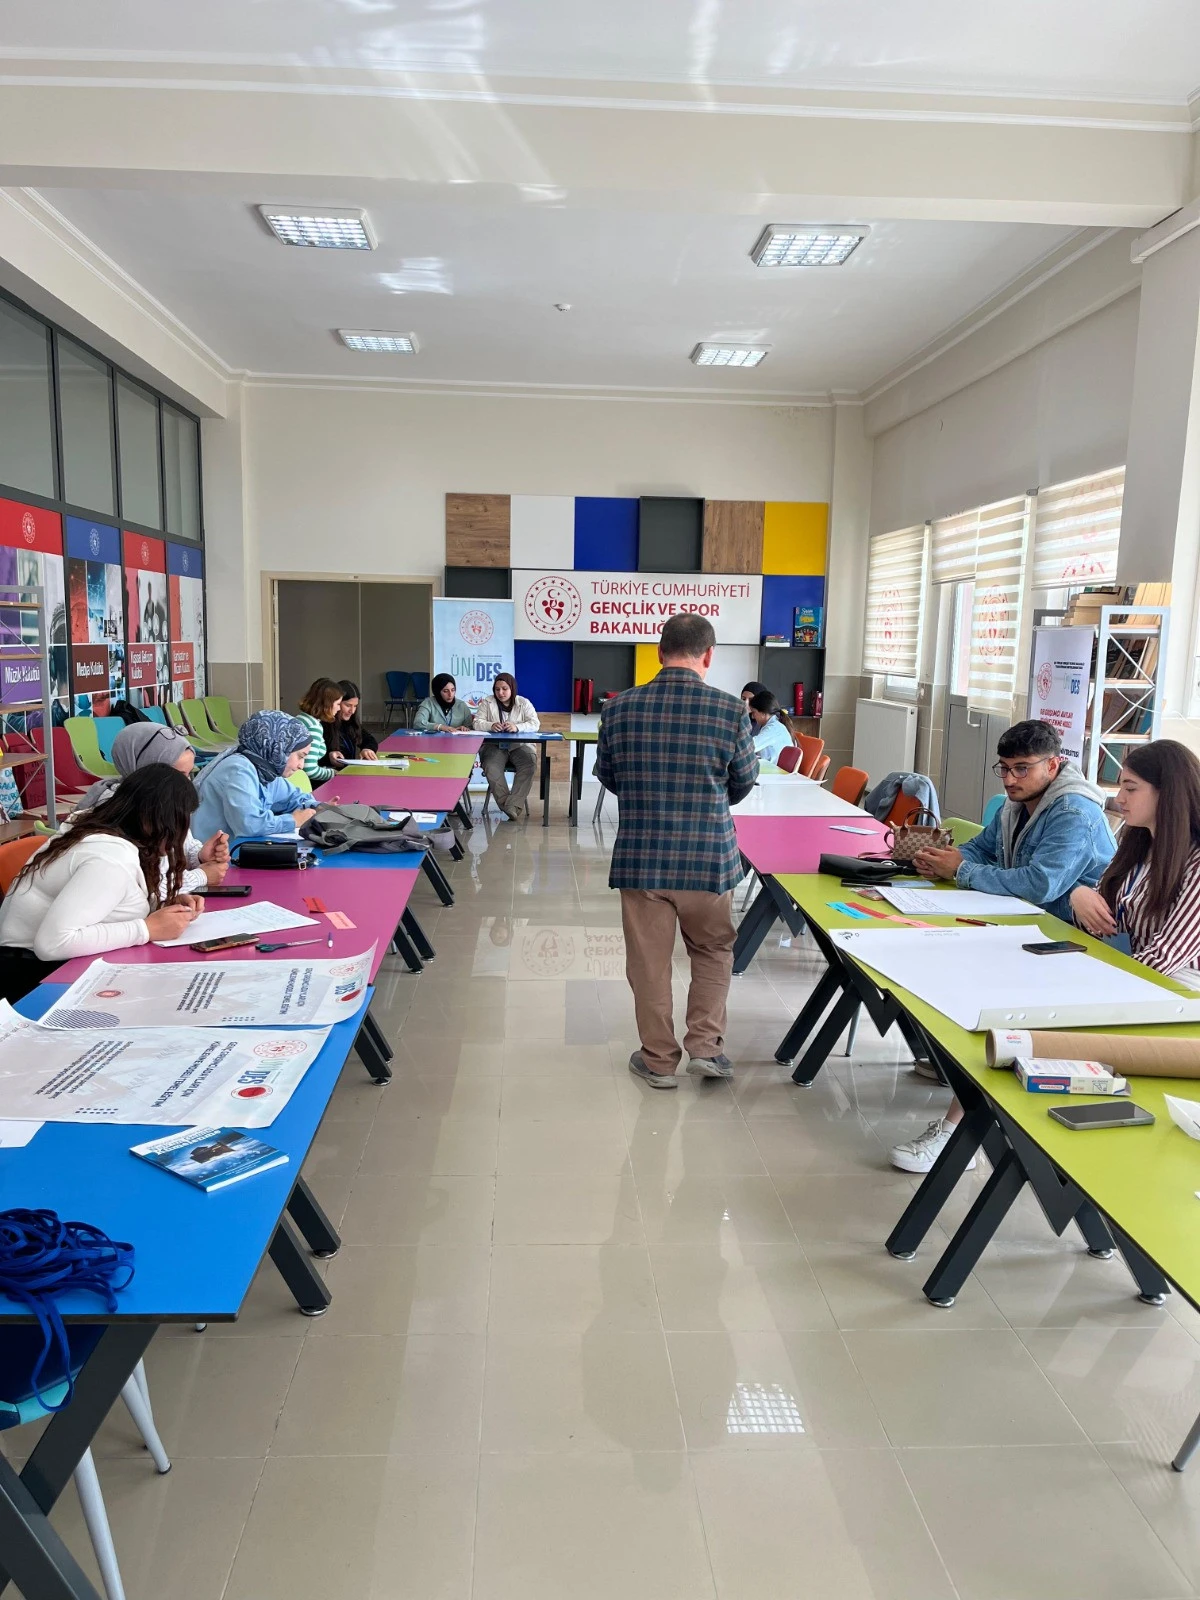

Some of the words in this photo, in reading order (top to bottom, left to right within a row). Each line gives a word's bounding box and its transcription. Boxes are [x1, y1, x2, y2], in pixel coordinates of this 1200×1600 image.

[590, 579, 650, 596] TÜRKİYE
[652, 581, 750, 598] CUMHURİYETİ
[590, 600, 654, 618] GENÇLİK
[657, 602, 676, 616] VE
[679, 602, 720, 617] SPOR
[590, 619, 666, 634] BAKANLIĞ
